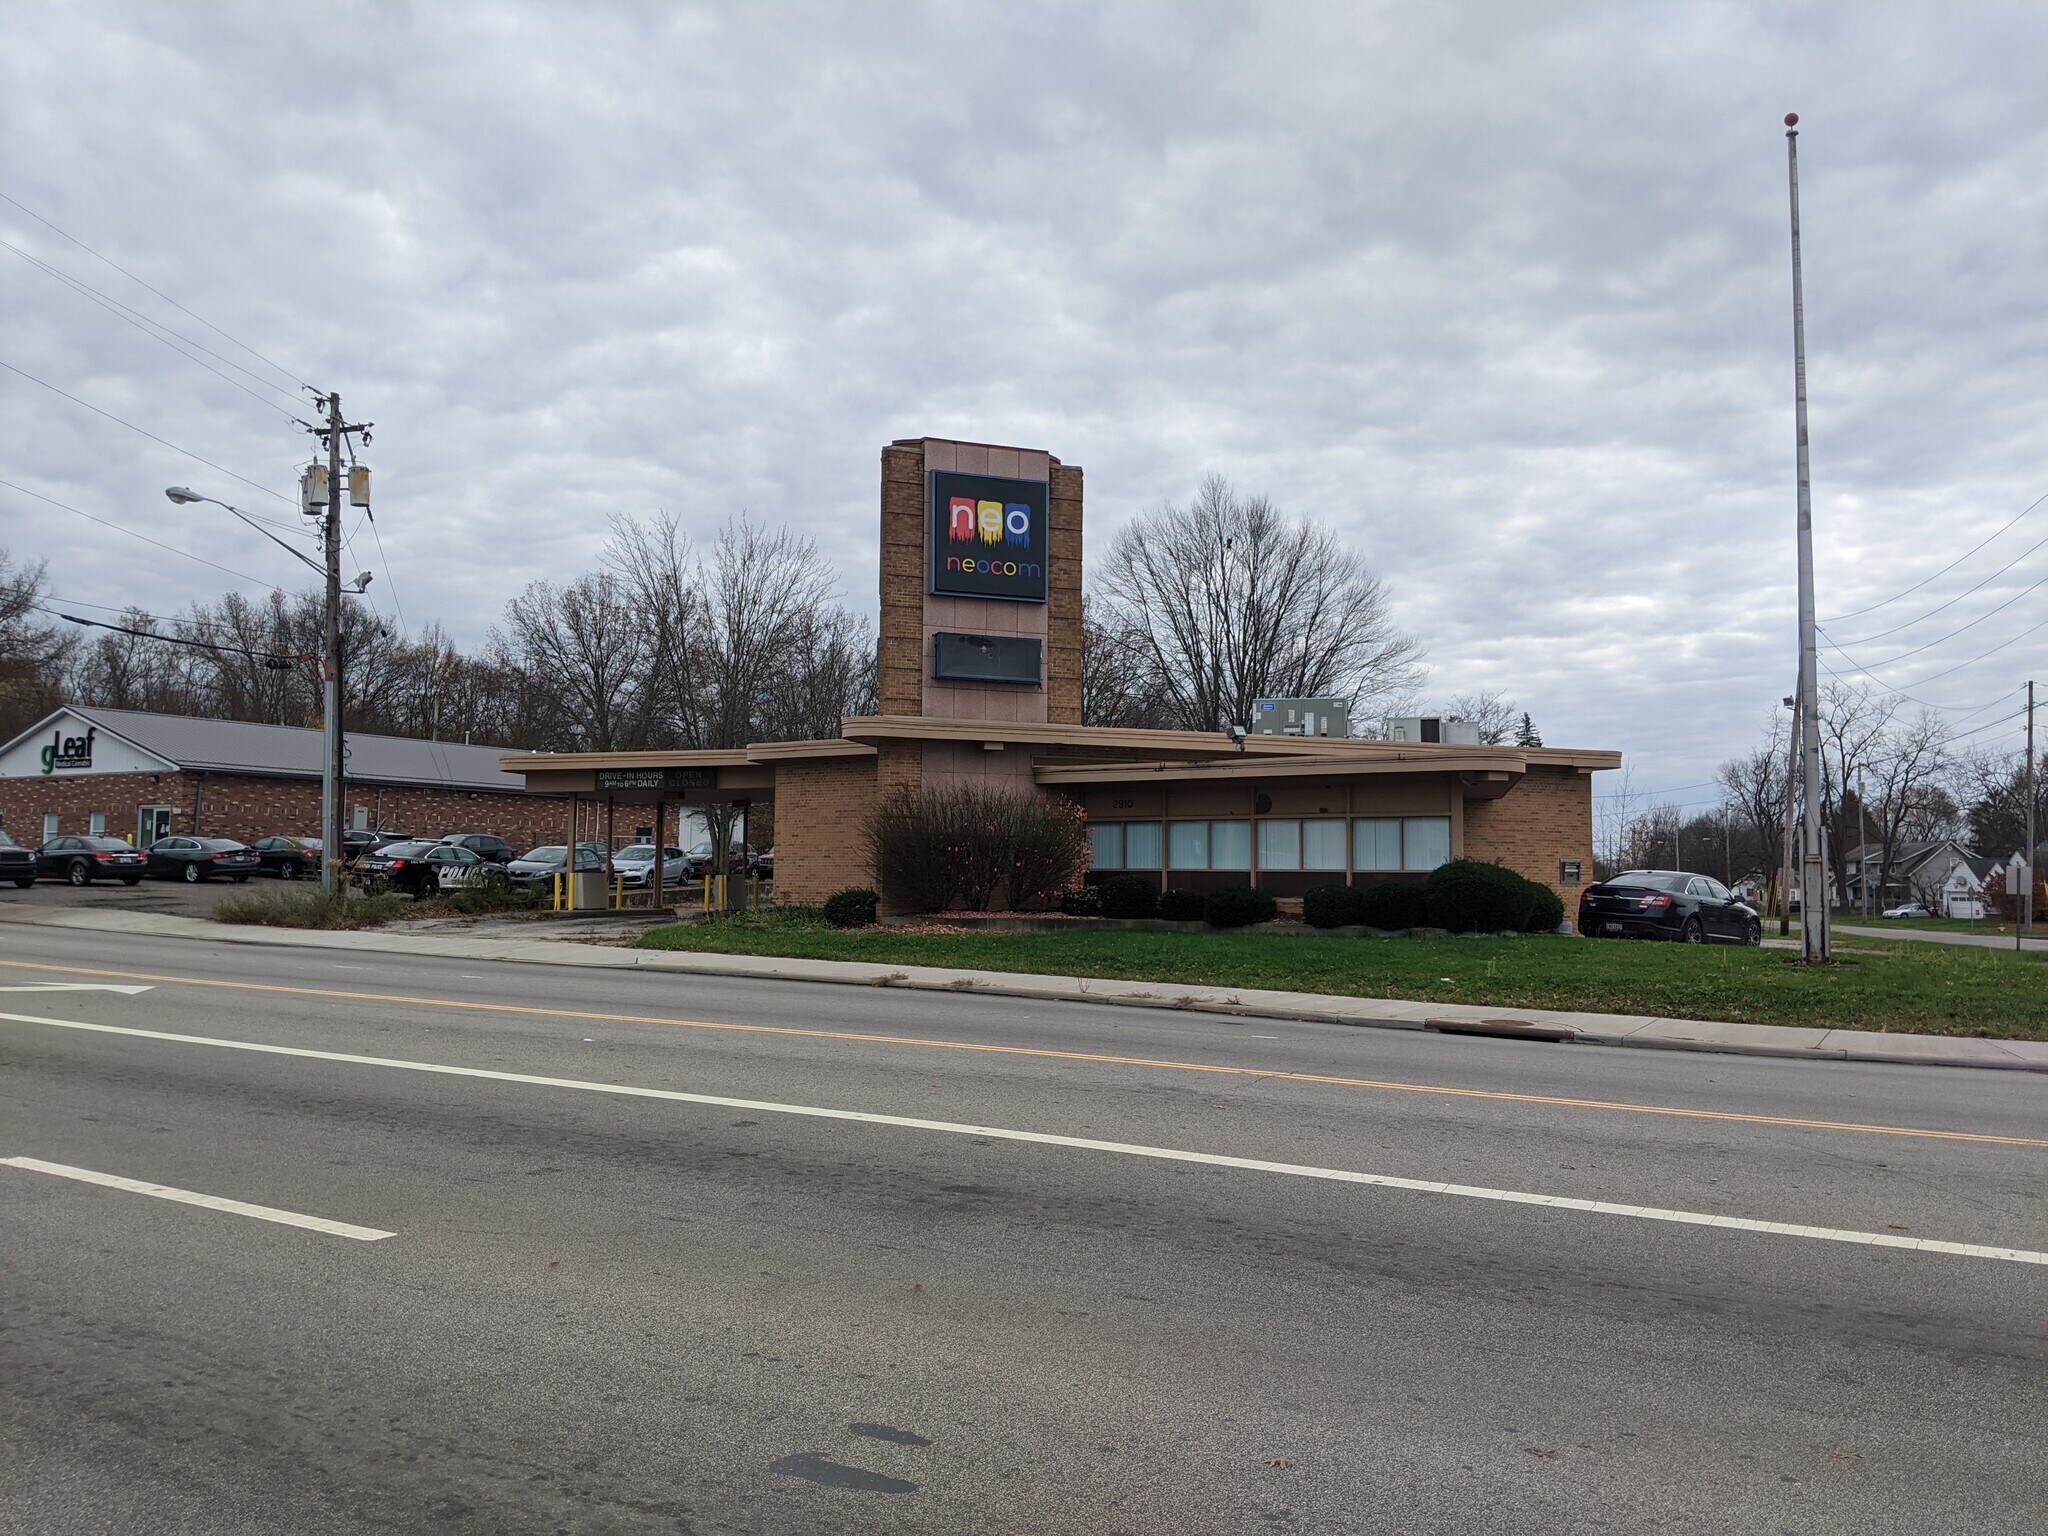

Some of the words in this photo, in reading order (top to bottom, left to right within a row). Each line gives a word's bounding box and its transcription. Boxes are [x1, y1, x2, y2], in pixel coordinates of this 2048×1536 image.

[952, 504, 1029, 535] neo
[947, 556, 1040, 578] neocom
[636, 771, 664, 780] HOURS
[675, 771, 703, 779] OPEN
[637, 779, 659, 788] DAILY
[668, 779, 710, 787] CLOSED
[1112, 799, 1134, 809] 2910
